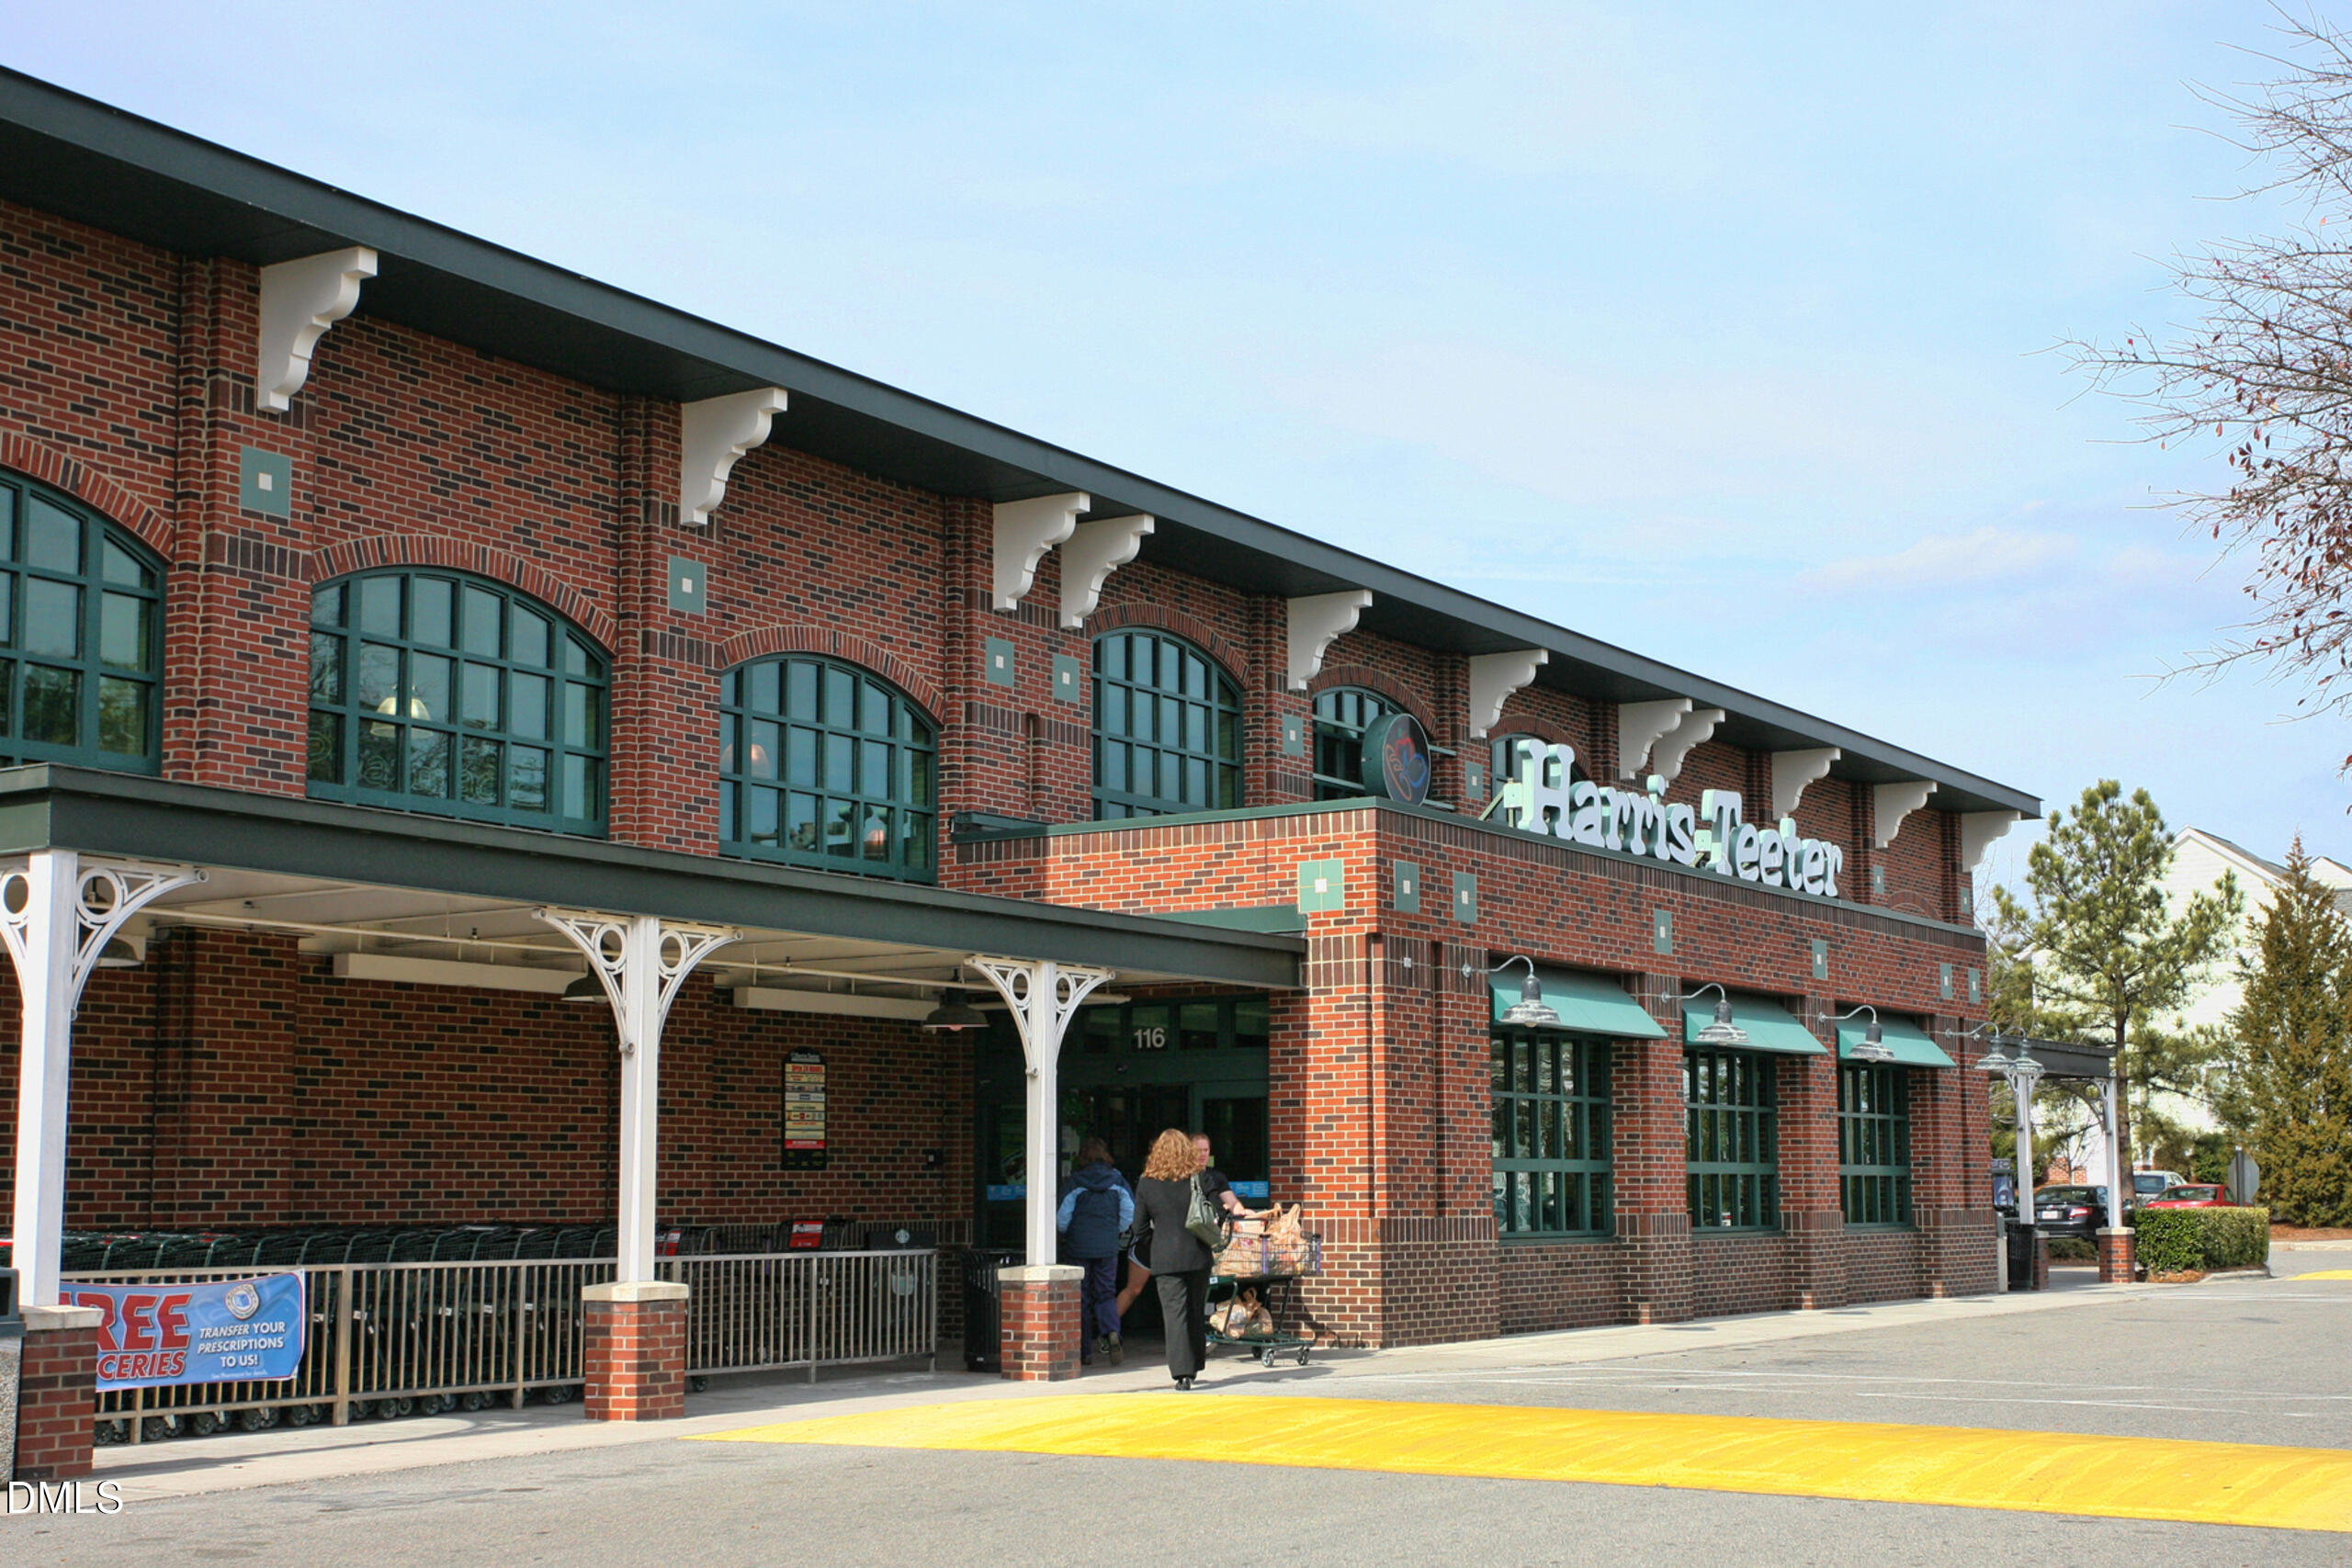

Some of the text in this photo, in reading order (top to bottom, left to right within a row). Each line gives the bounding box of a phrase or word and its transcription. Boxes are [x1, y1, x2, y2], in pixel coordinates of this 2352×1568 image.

[1517, 739, 1843, 897] Harris Teeter
[1134, 1027, 1165, 1048] 116
[59, 1292, 192, 1352] REE
[198, 1321, 286, 1339] TRANSFER YOUR
[197, 1337, 284, 1354] PRESCRIPTIONS
[96, 1350, 187, 1381] CERIES
[220, 1354, 258, 1368] TO US!
